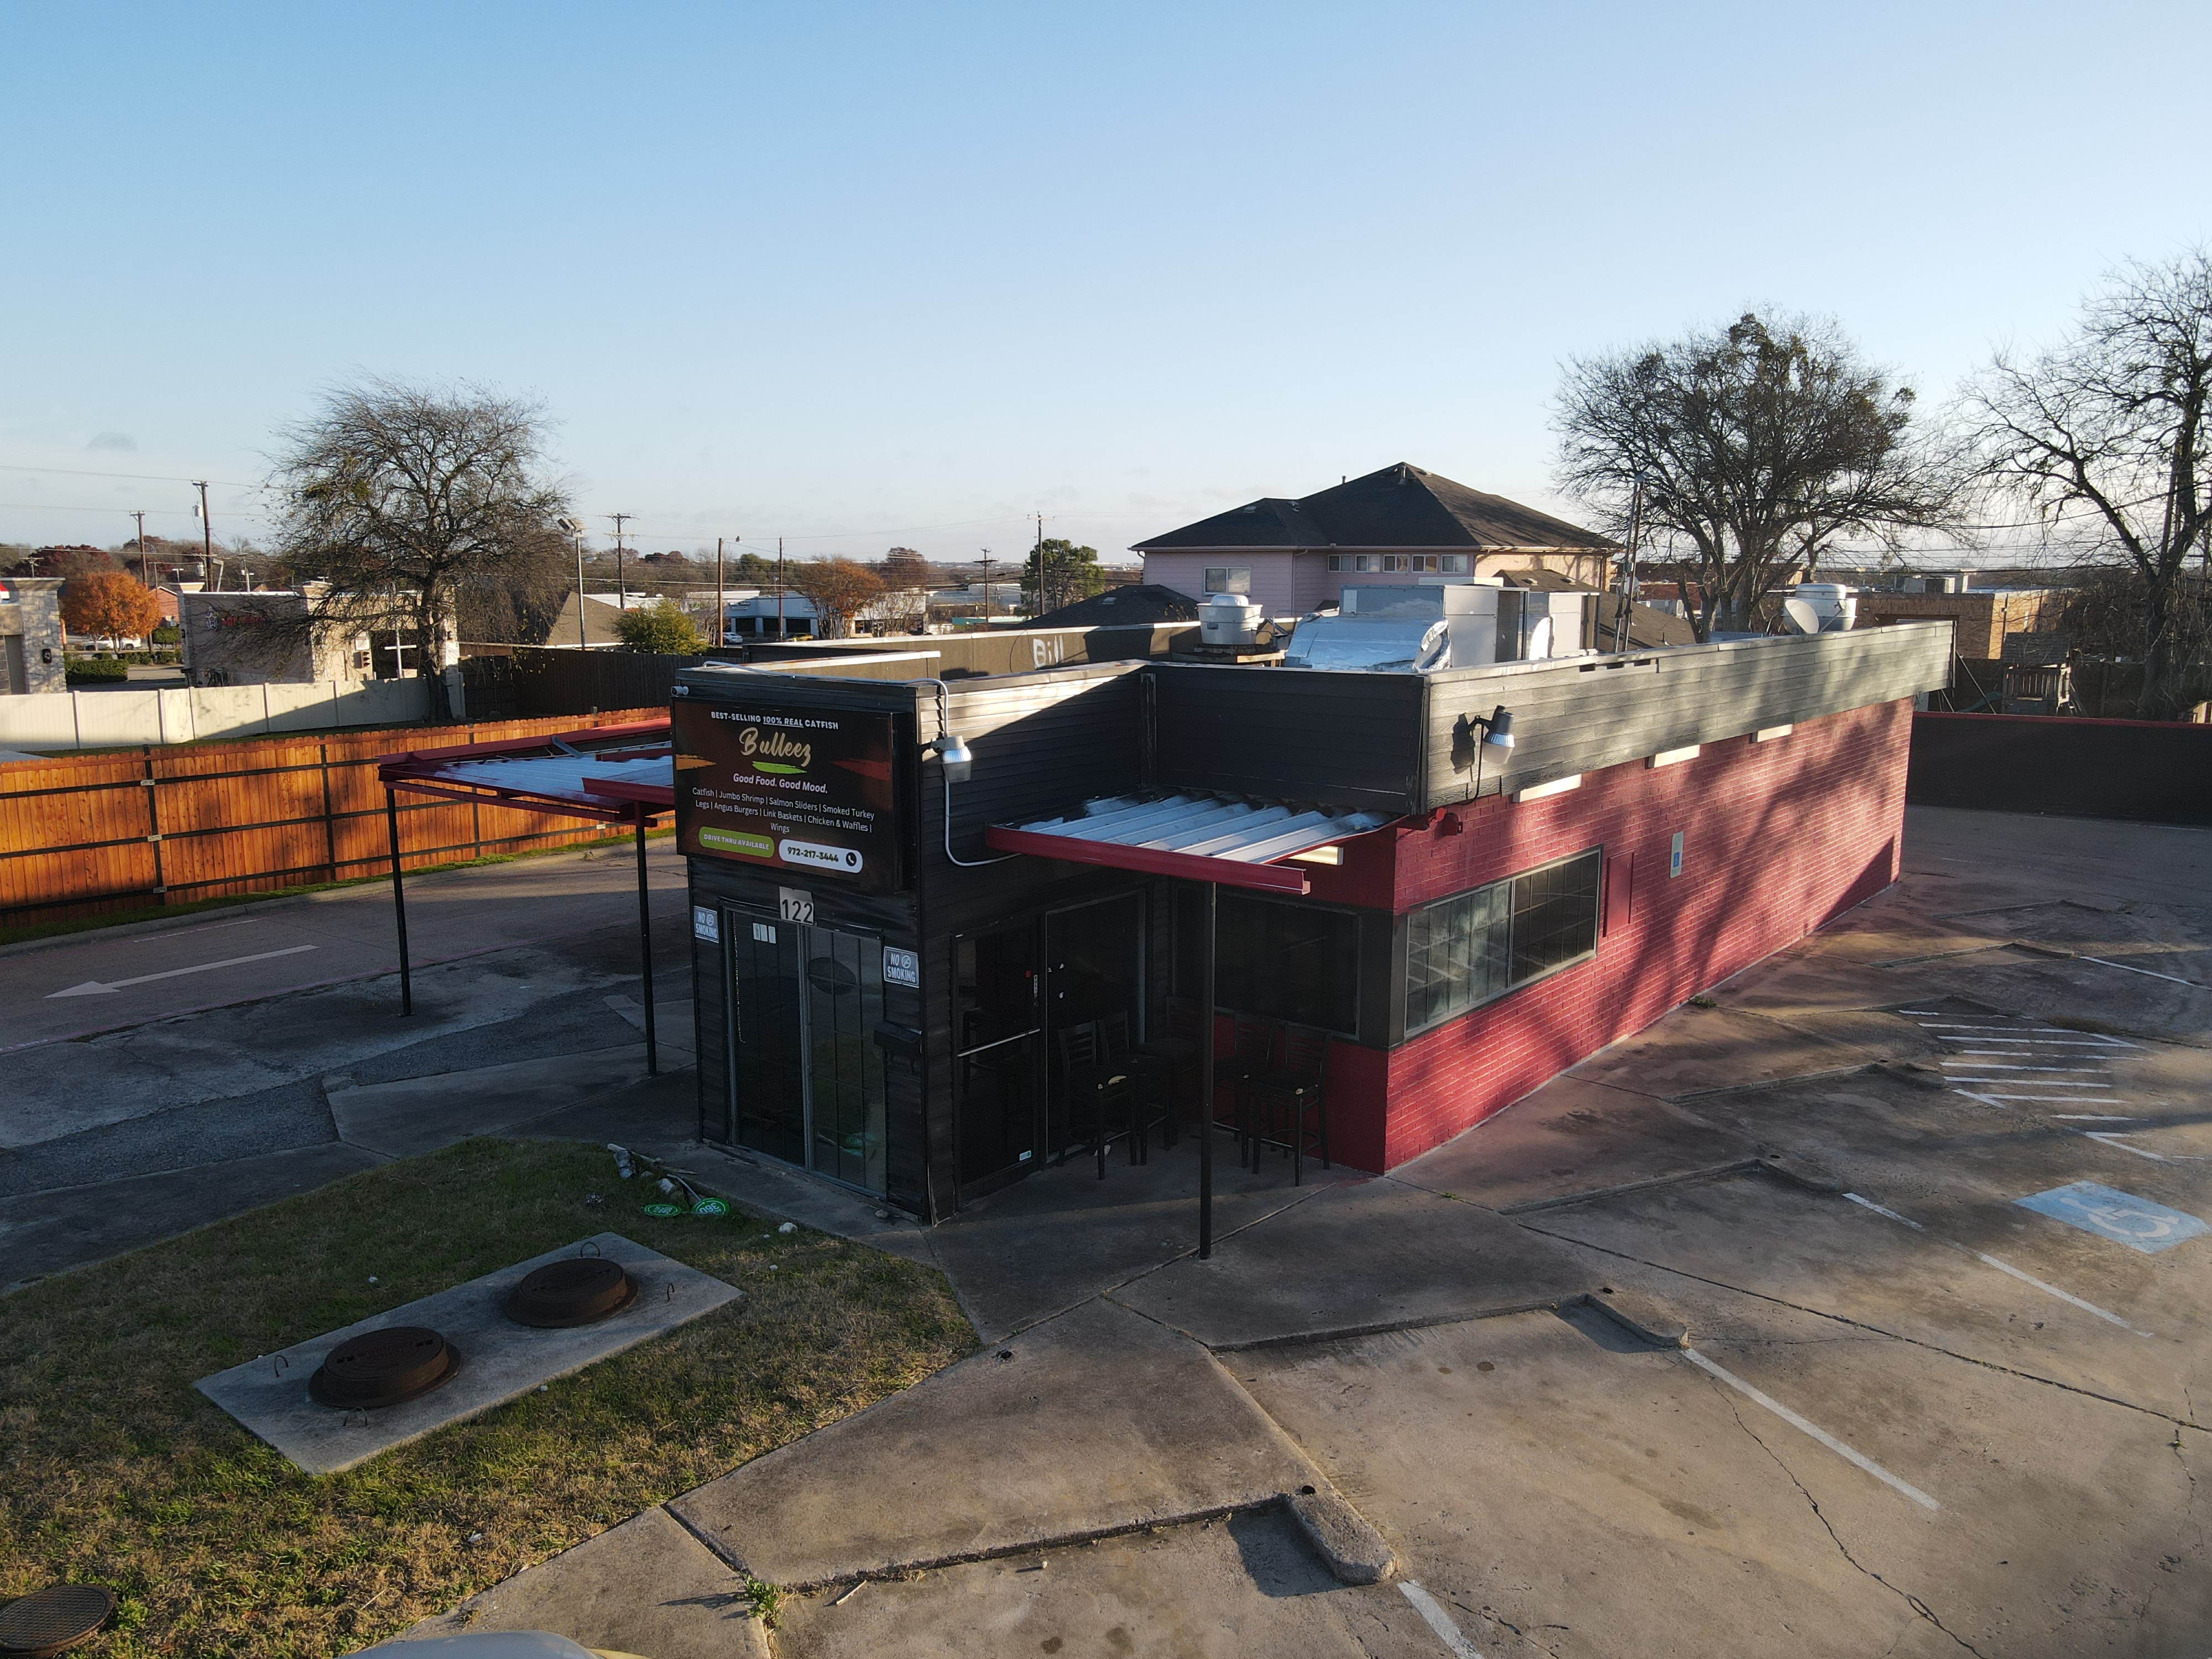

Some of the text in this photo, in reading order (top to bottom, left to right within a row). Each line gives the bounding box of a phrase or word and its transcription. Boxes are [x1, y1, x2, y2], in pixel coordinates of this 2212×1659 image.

[1033, 635, 1064, 669] Bill
[711, 712, 761, 722] BEST-SELLING
[763, 716, 782, 724] 100%
[805, 719, 838, 729] CATFISH
[739, 727, 811, 767] Bulleez
[733, 774, 754, 784] Good
[779, 779, 800, 790] Good
[802, 781, 828, 794] Mood.
[692, 787, 714, 796] Catfish
[719, 791, 740, 800] Jumbo
[742, 794, 764, 805] Shrimp
[769, 797, 793, 807] Salmon
[795, 801, 818, 811] Sliders
[822, 804, 850, 815] Smoked
[851, 808, 875, 821] Turkey
[696, 800, 709, 810] Legs
[714, 802, 733, 812] Angus
[734, 805, 758, 816] Burgers
[763, 810, 776, 818] Link
[778, 811, 802, 822] Baskets
[807, 816, 834, 827] Chicken
[842, 820, 868, 831] Waffles
[770, 822, 790, 834] Wings
[738, 839, 769, 850] AVAILABLE
[698, 912, 705, 924] NO
[782, 899, 812, 924] 122
[696, 923, 717, 938] SMOKING
[890, 953, 900, 966] NO
[887, 966, 915, 982] SMOKING
